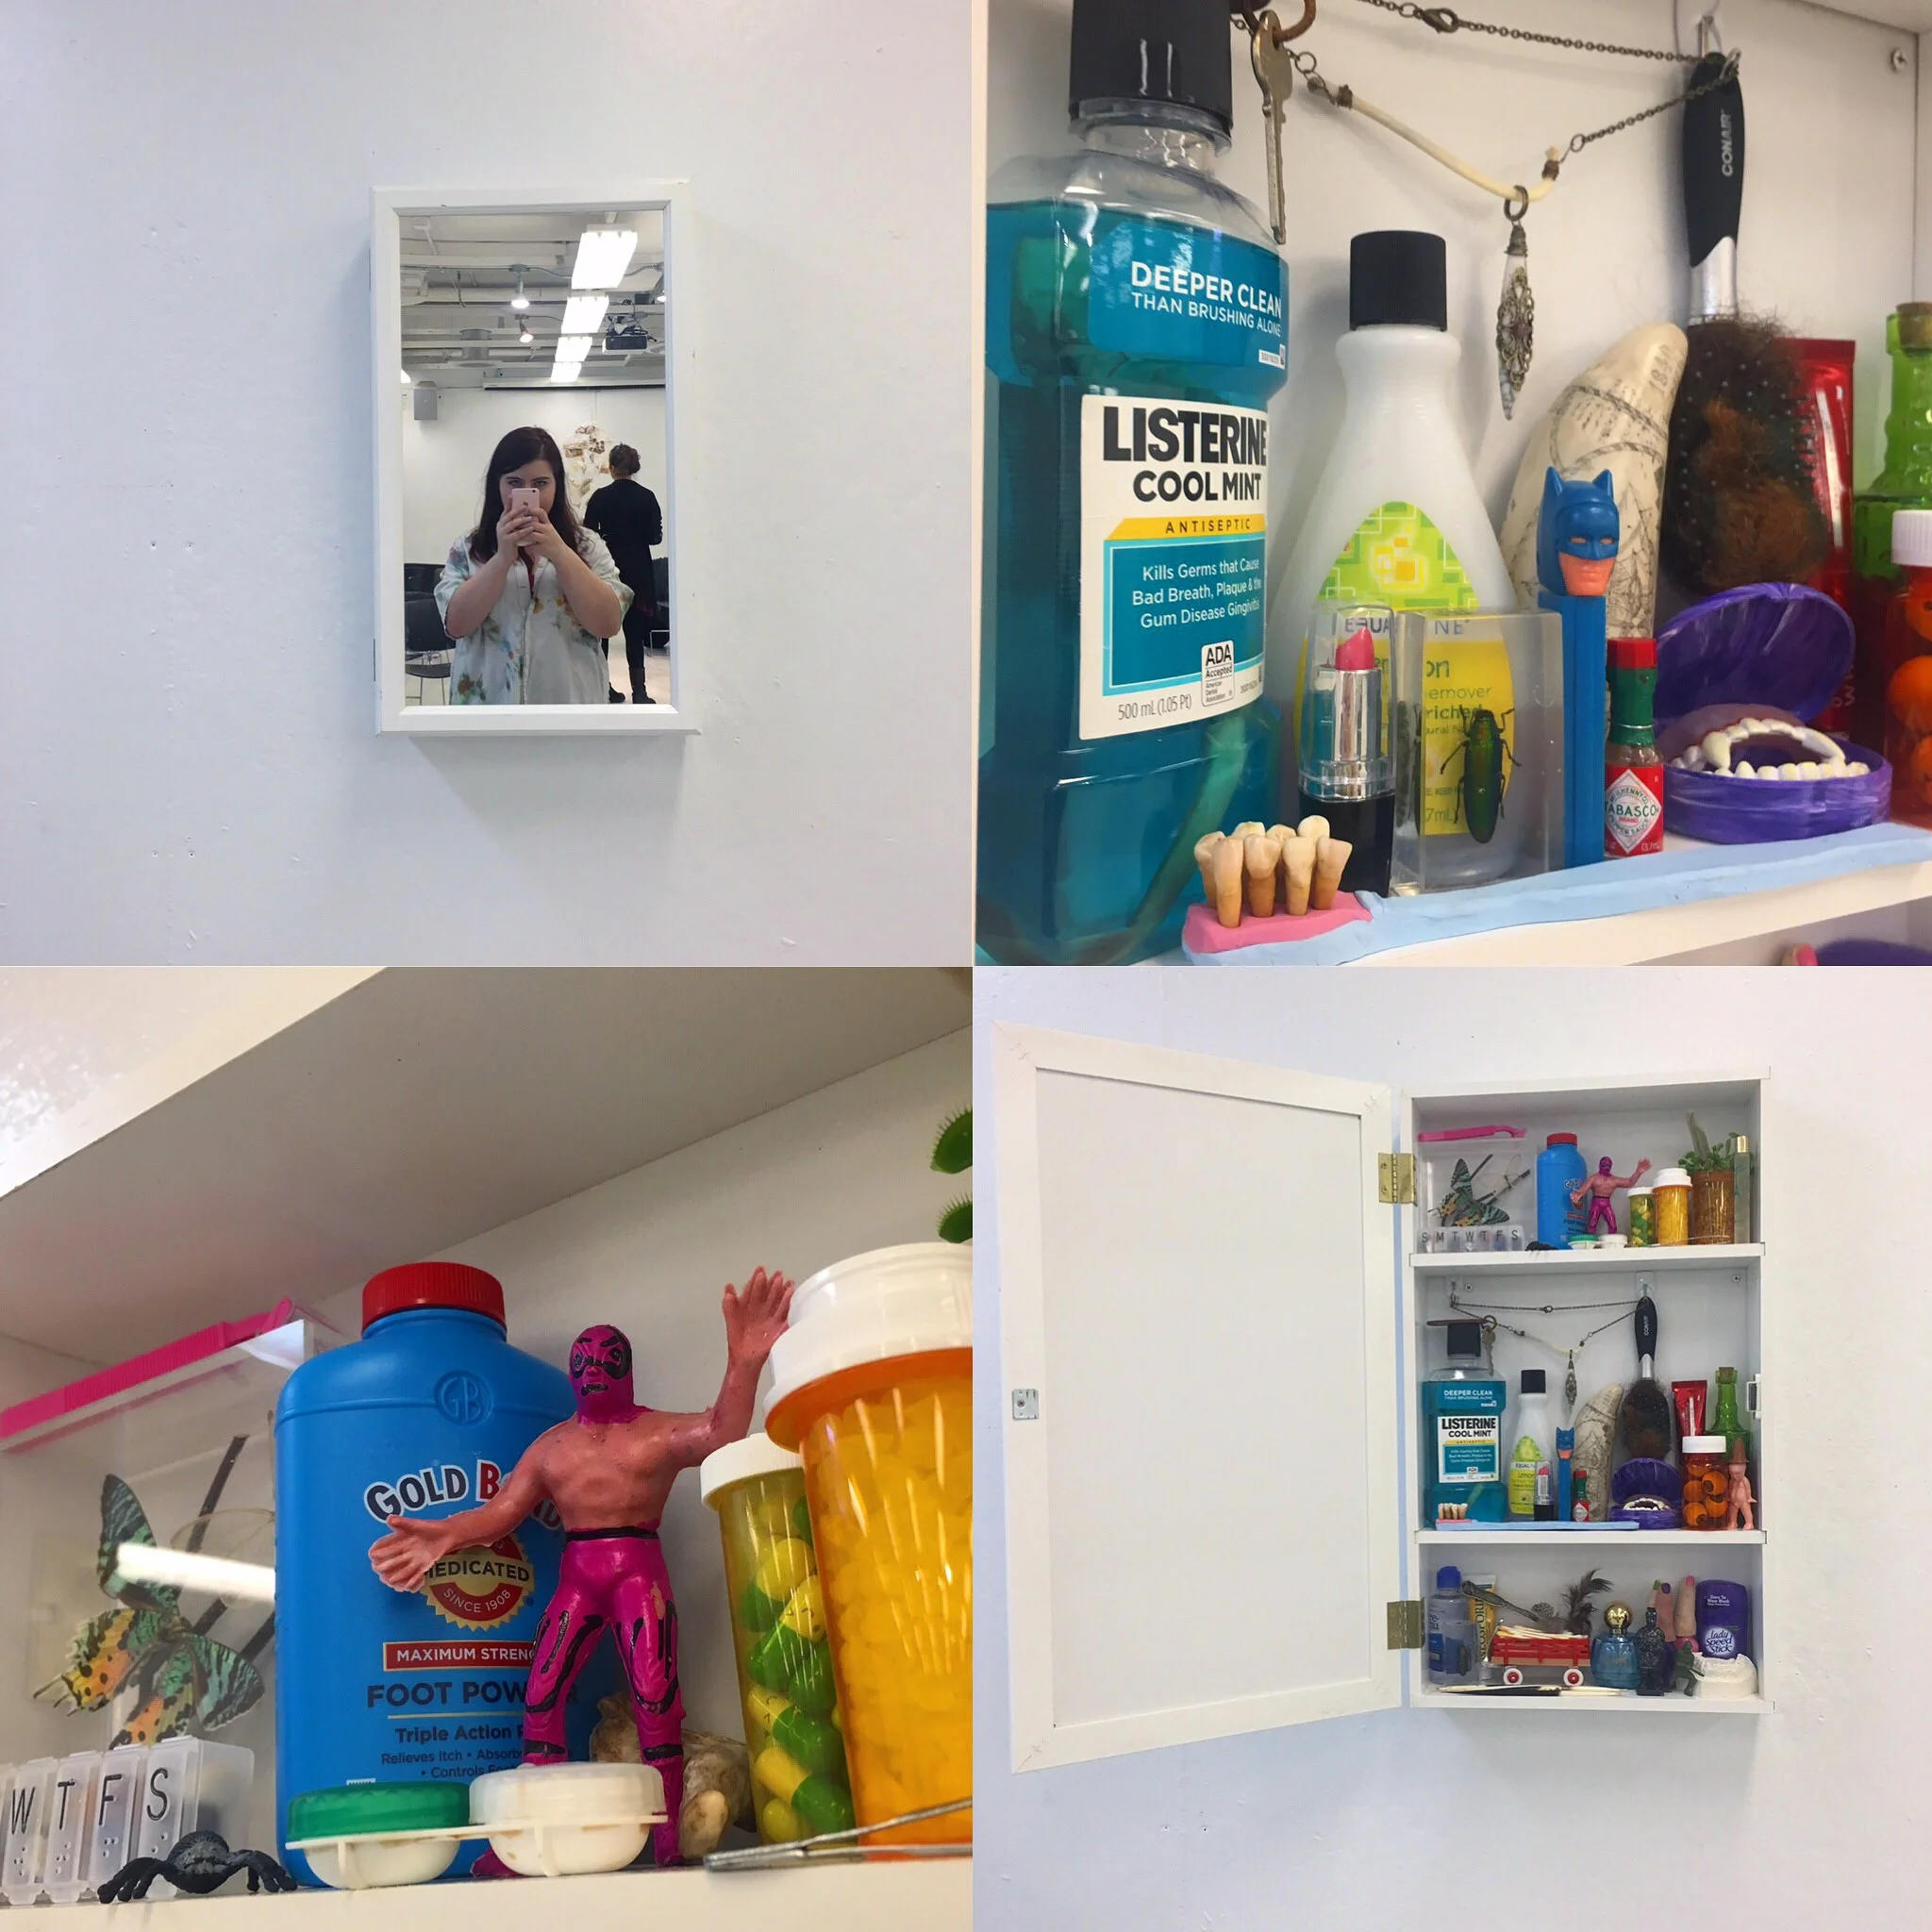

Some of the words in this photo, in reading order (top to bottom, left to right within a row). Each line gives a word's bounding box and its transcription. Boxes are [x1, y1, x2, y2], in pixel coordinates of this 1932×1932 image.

[1720, 108, 1733, 176] CONAIR
[1131, 260, 1233, 304] DEEPER
[1237, 283, 1282, 320] CLEAN
[1131, 291, 1183, 315] THAN
[1188, 301, 1255, 329] BRUSHING
[1257, 316, 1282, 338] ALONE
[1103, 406, 1267, 466] LISTERINE
[1133, 470, 1219, 503] COOL
[1222, 472, 1261, 501] MINT
[1165, 518, 1251, 534] ANTISEPTIC
[1142, 564, 1174, 581] Kills
[1178, 563, 1217, 578] Germs
[1219, 560, 1239, 575] that
[1240, 558, 1259, 573] Cause
[1132, 589, 1164, 606] Bad
[1168, 585, 1214, 603] Breath,
[1216, 581, 1247, 597] Plaque
[1254, 577, 1262, 591] the
[1141, 613, 1177, 628] Gum
[1180, 608, 1225, 624] Disease
[1227, 598, 1260, 617] Gingivitis
[1205, 643, 1232, 667] ADA
[1206, 665, 1232, 679] Accepted
[1426, 687, 1493, 700] emover
[1118, 704, 1139, 721] 500
[1141, 701, 1156, 717] mL
[1158, 696, 1179, 716] (1.05
[1179, 693, 1192, 710] Pt)
[1421, 1232, 1429, 1243] S
[1436, 1231, 1444, 1241] M
[1451, 1231, 1458, 1241] T
[1465, 1231, 1474, 1241] W
[1480, 1229, 1488, 1241] T
[1495, 1229, 1503, 1241] F
[1511, 1229, 1519, 1241] S
[1441, 1417, 1496, 1430] LISTERINE
[365, 1466, 468, 1523] GOLD
[442, 1588, 481, 1613] SINCE
[485, 1589, 511, 1612] 1908
[1706, 1635, 1733, 1647] Speed
[1710, 1644, 1732, 1654] Stick
[396, 1647, 476, 1662] MAXIMUM
[367, 1682, 452, 1708] FOOT
[462, 1679, 528, 1705] POW
[394, 1725, 449, 1745] Triple
[454, 1724, 512, 1740] Action
[381, 1751, 435, 1765] Relieves
[439, 1749, 462, 1761] Itch
[475, 1748, 523, 1761] Absorb
[430, 1765, 484, 1778] Controls
[11, 1786, 36, 1836] W
[57, 1780, 75, 1830] T
[98, 1774, 123, 1826] F
[146, 1767, 169, 1822] S
